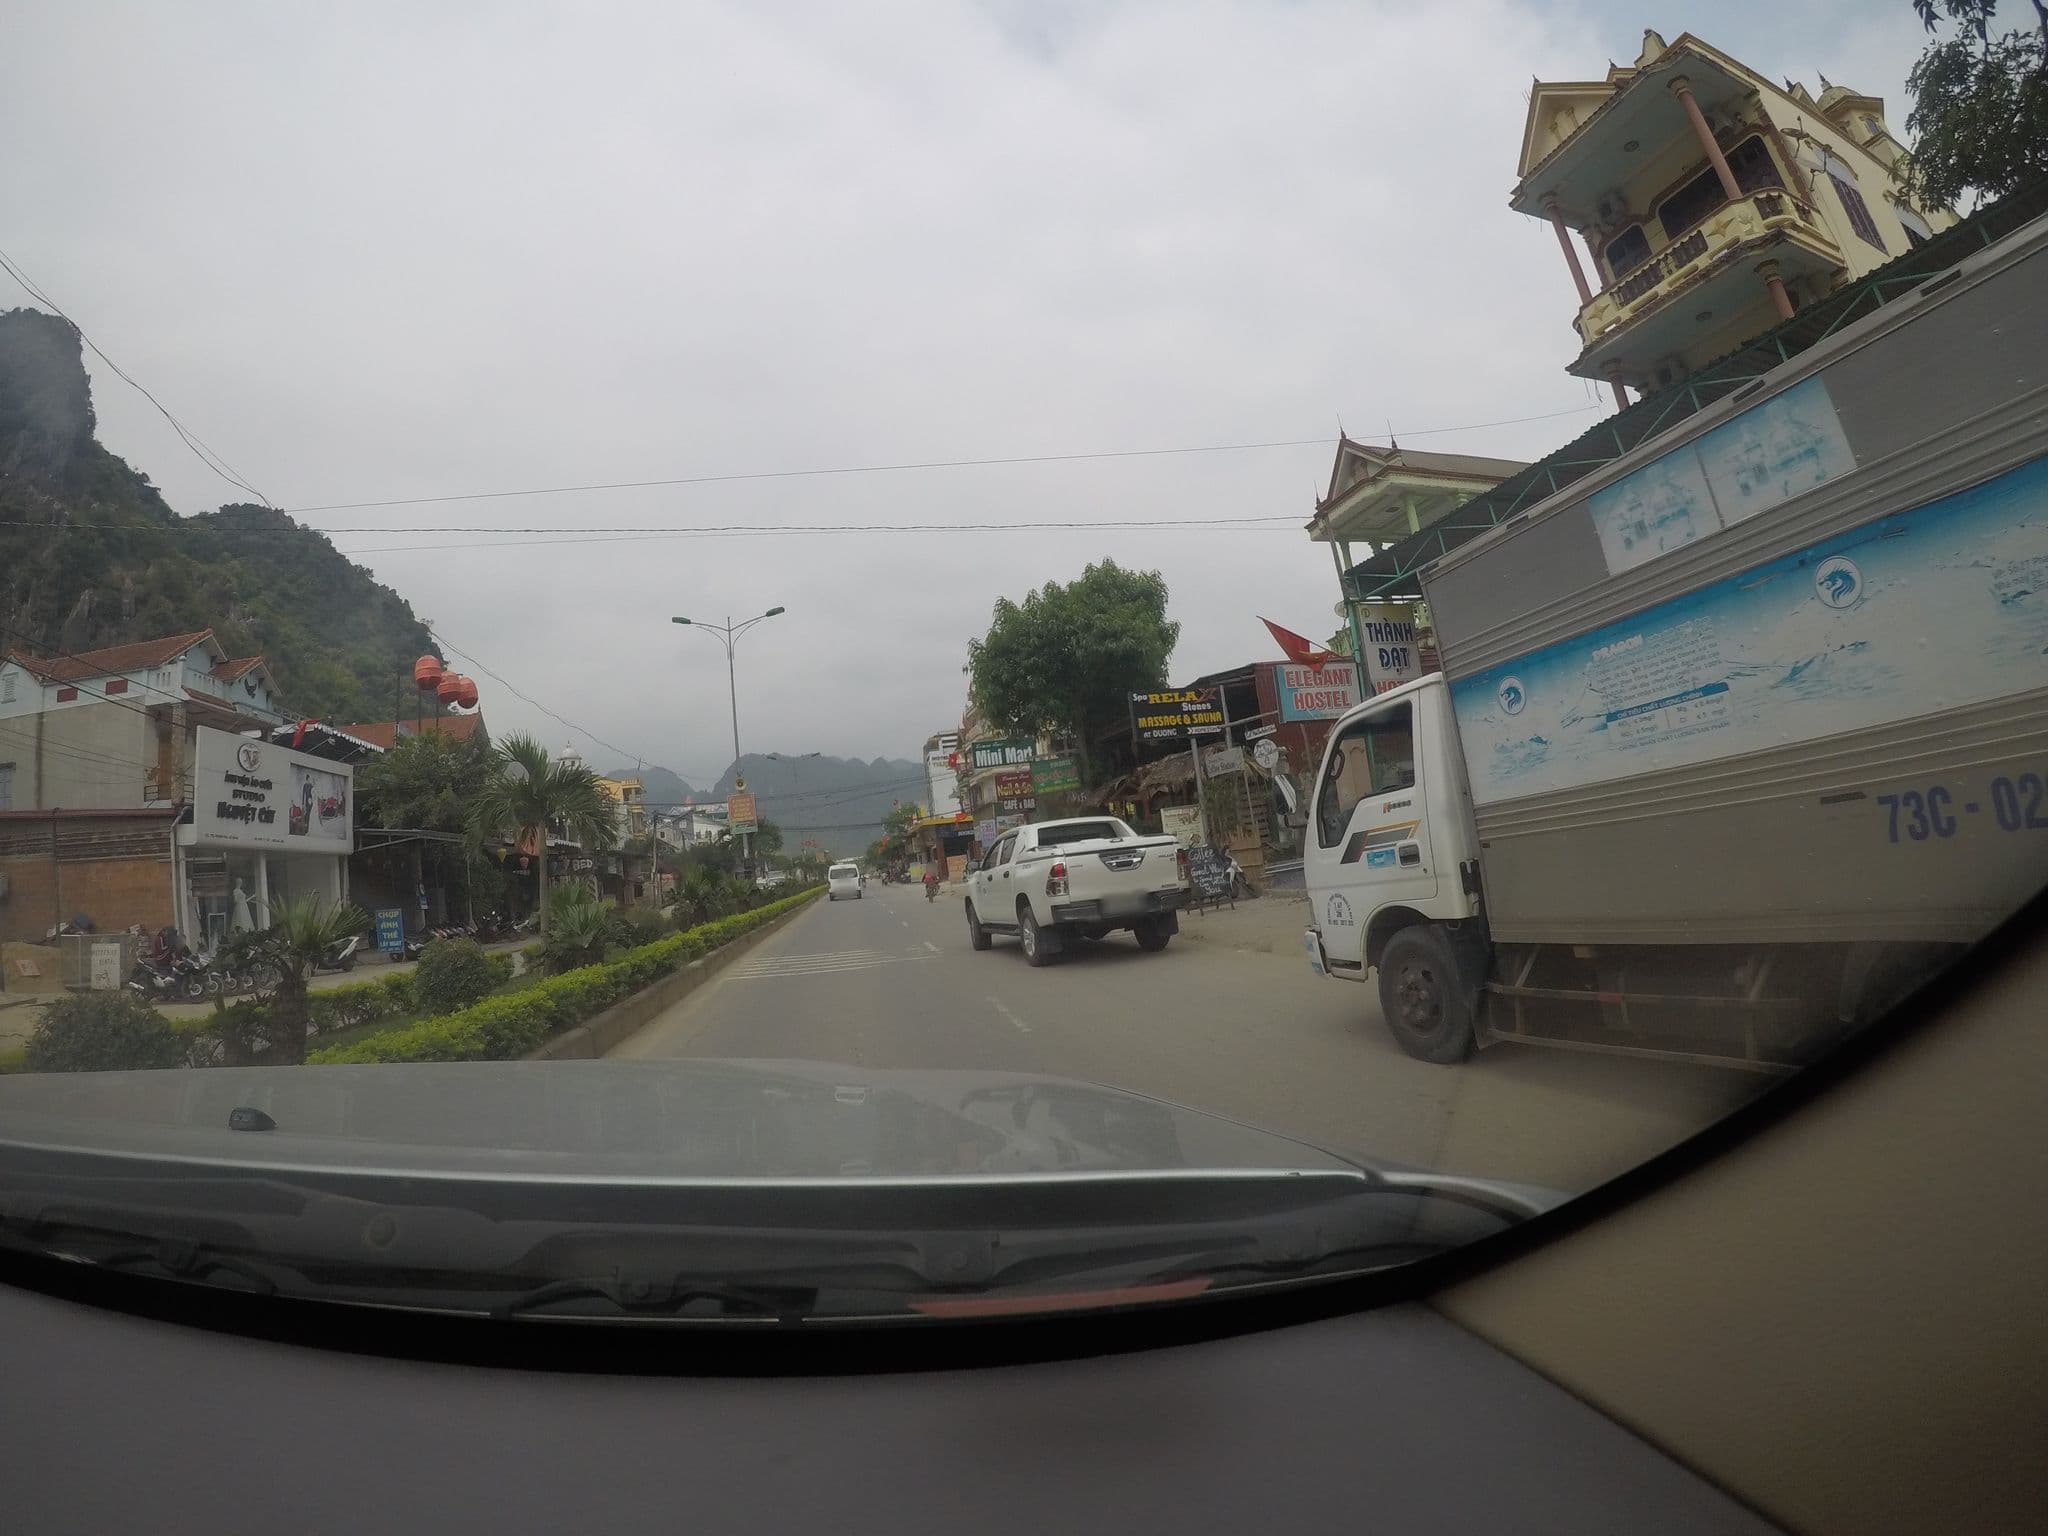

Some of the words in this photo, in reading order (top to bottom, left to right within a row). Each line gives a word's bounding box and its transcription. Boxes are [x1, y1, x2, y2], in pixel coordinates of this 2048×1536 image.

[1365, 618, 1414, 642] THÀNH
[1379, 647, 1409, 673] ĐẠT
[1285, 669, 1352, 688] ELEGANT
[1148, 688, 1218, 704] RELAX
[1293, 691, 1352, 710] HOSTEL
[1137, 715, 1182, 728] MASSAGE
[1183, 716, 1191, 725] &
[1193, 712, 1222, 723] SAUNA
[976, 749, 1001, 767] Mini
[1005, 746, 1034, 763] Mart
[1877, 786, 1957, 843] 73C
[1990, 773, 2048, 832] 02
